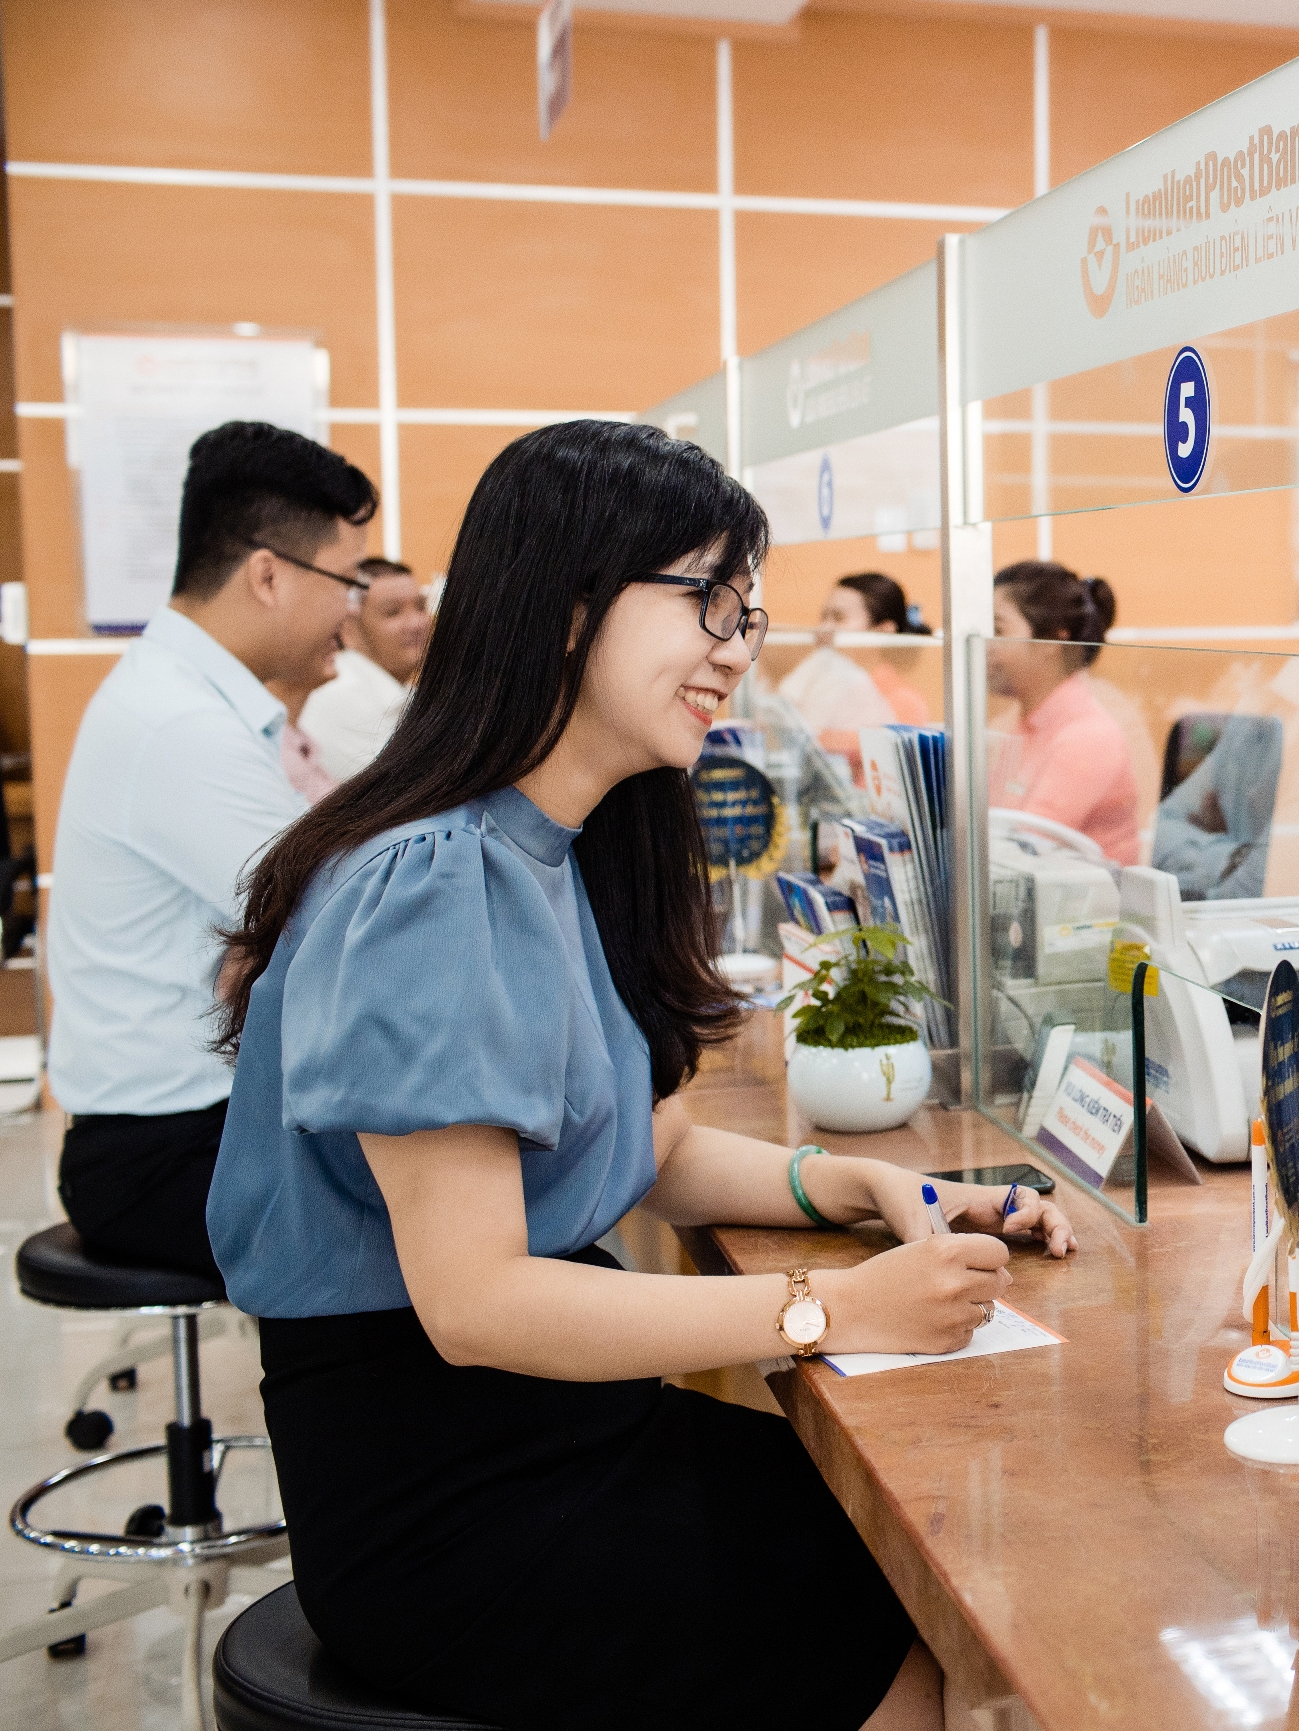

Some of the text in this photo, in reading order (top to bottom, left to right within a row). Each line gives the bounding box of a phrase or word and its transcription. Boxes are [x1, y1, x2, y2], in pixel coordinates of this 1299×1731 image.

[1125, 256, 1154, 309] NGÂN
[1158, 246, 1189, 298] HÀNG
[1254, 205, 1285, 264] LIÊN
[1177, 381, 1196, 459] 5
